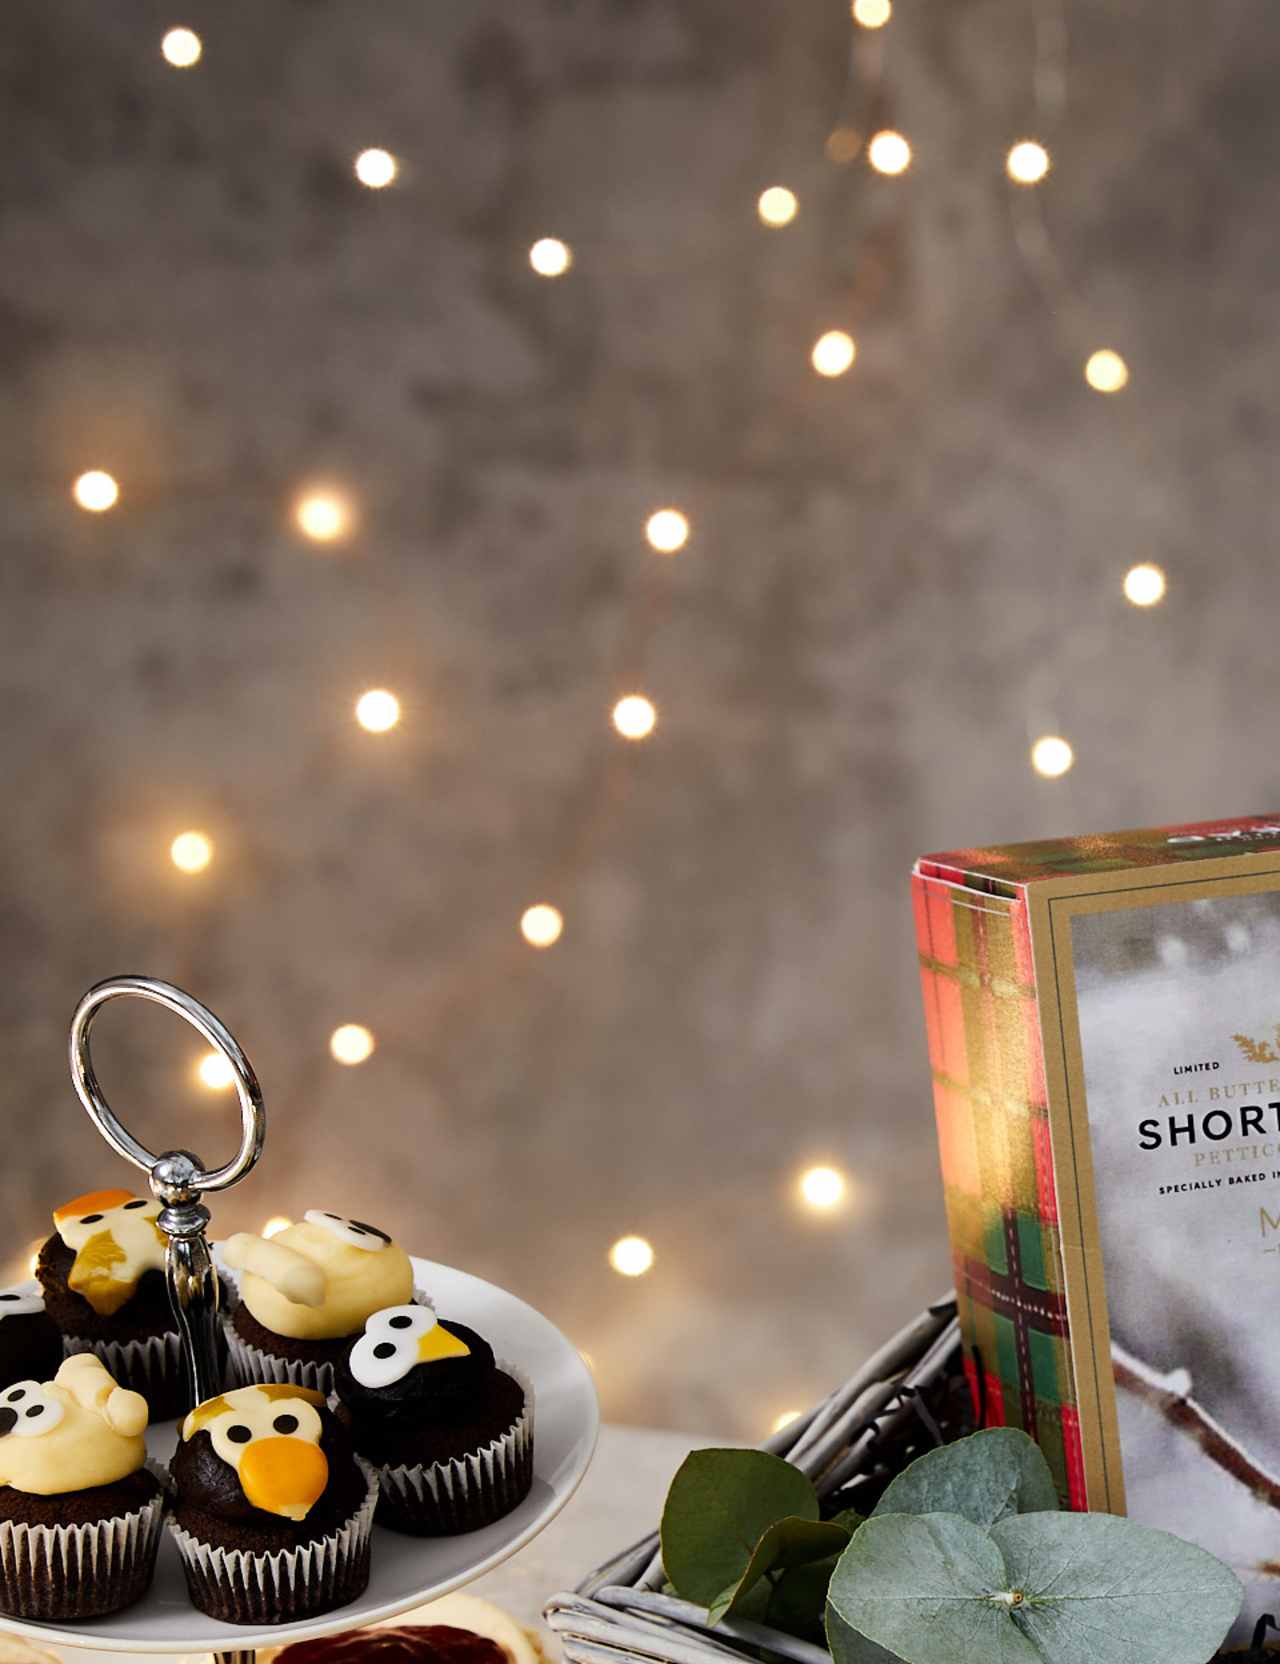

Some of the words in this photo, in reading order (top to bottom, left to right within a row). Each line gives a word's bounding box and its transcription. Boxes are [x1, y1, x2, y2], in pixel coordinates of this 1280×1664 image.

[1173, 1061, 1220, 1075] LIMITED
[1158, 1088, 1199, 1108] ALL
[1159, 1179, 1222, 1195] SPECIALLY
[1228, 1172, 1266, 1186] BAKED
